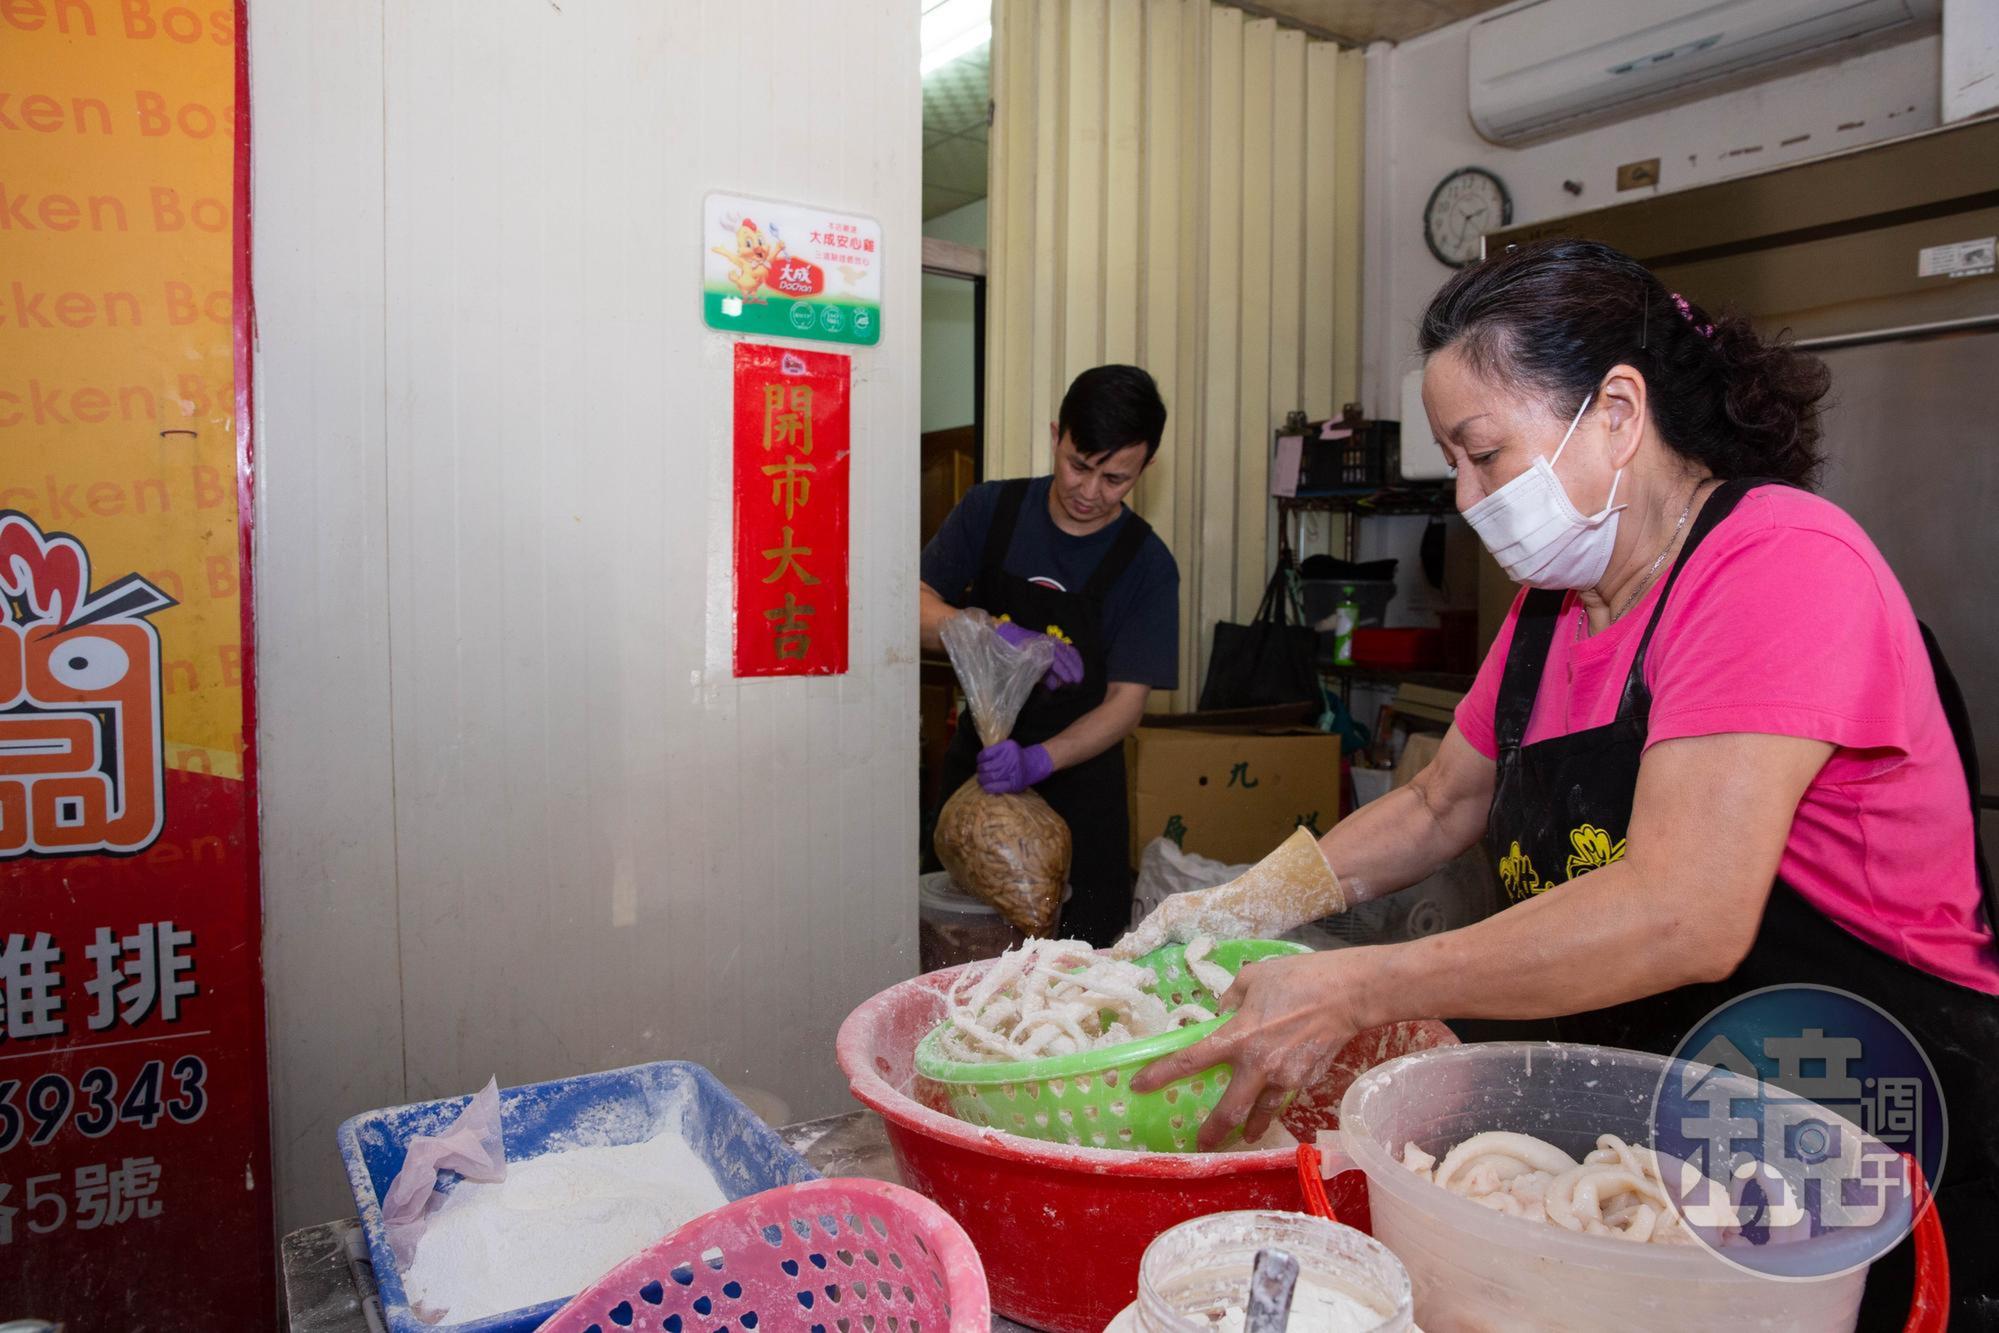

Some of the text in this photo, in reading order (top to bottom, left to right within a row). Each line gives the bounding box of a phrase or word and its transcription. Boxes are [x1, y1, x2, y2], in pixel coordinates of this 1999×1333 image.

[0, 280, 142, 329] ken
[760, 383, 822, 660] 開市大吉
